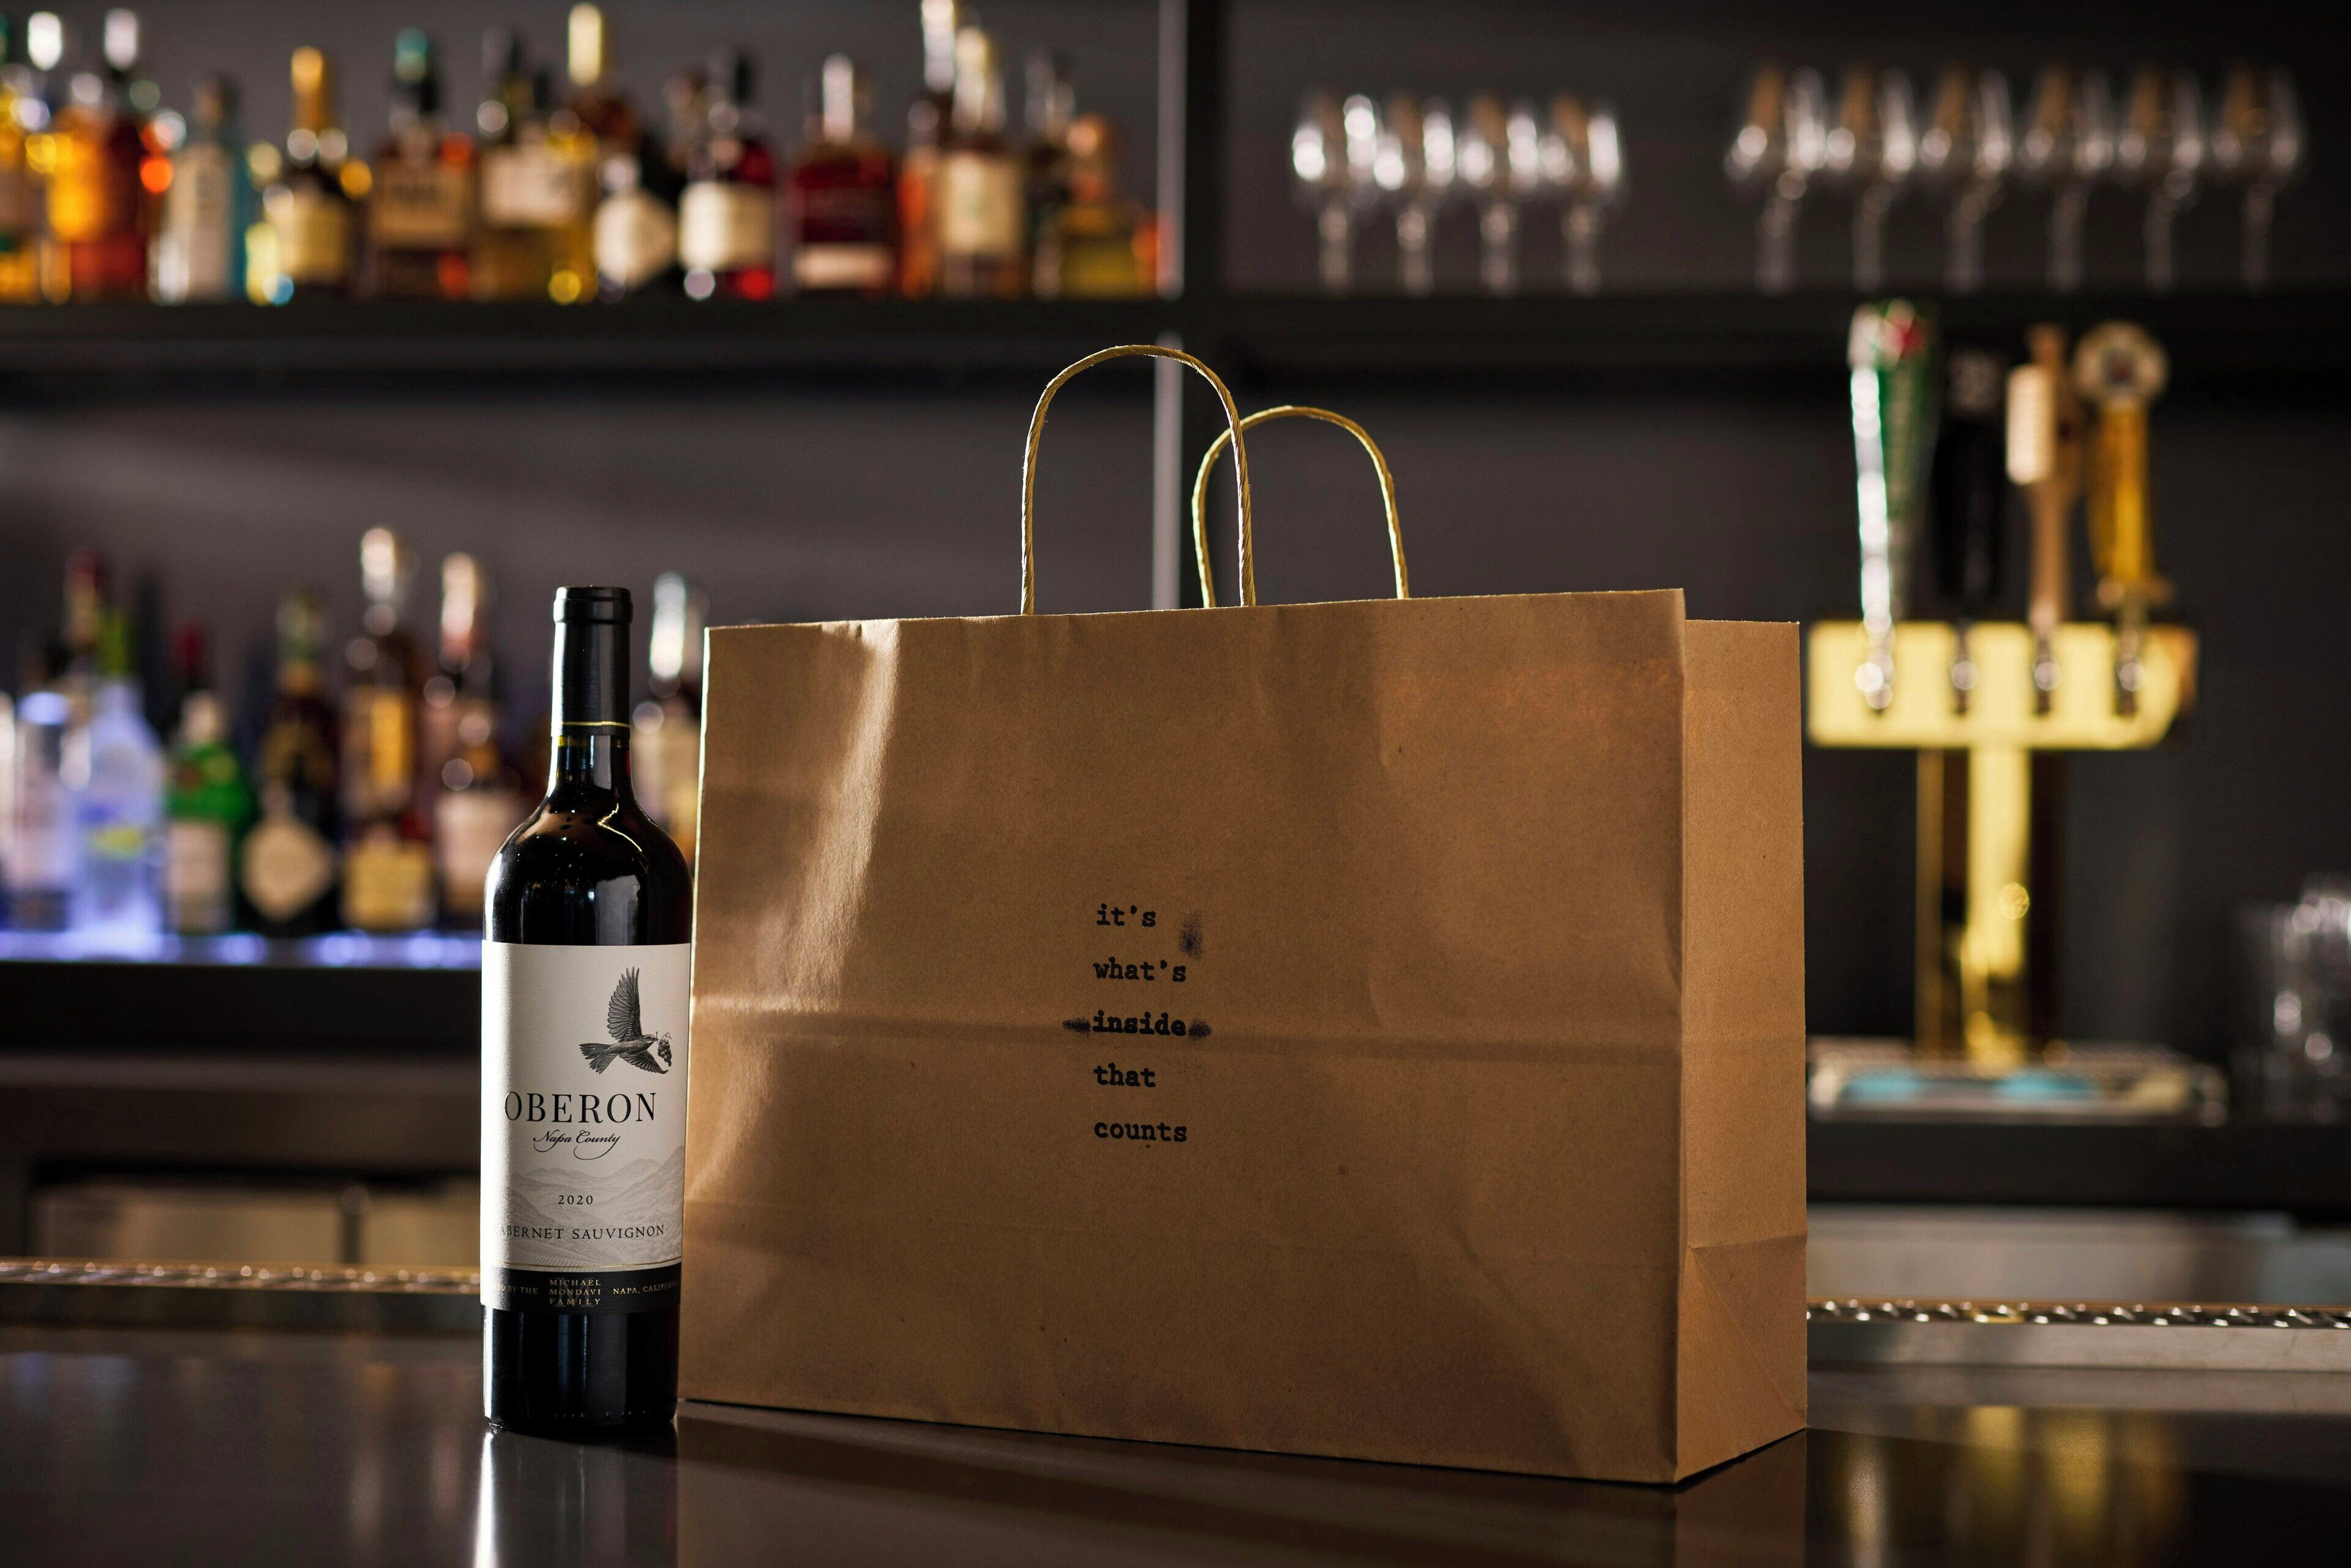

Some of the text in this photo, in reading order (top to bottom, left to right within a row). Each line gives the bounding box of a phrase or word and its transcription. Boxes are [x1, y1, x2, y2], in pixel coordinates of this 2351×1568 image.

[1096, 903, 1157, 928] it's
[1093, 956, 1187, 982] what's
[1092, 1010, 1187, 1037] inside
[1093, 1062, 1156, 1087] that
[504, 1091, 657, 1124] OBERON
[1094, 1122, 1187, 1142] counts
[533, 1129, 621, 1161] Napa County
[557, 1195, 594, 1205] 2020
[495, 1225, 664, 1240] ABERNET SAUVIGNON
